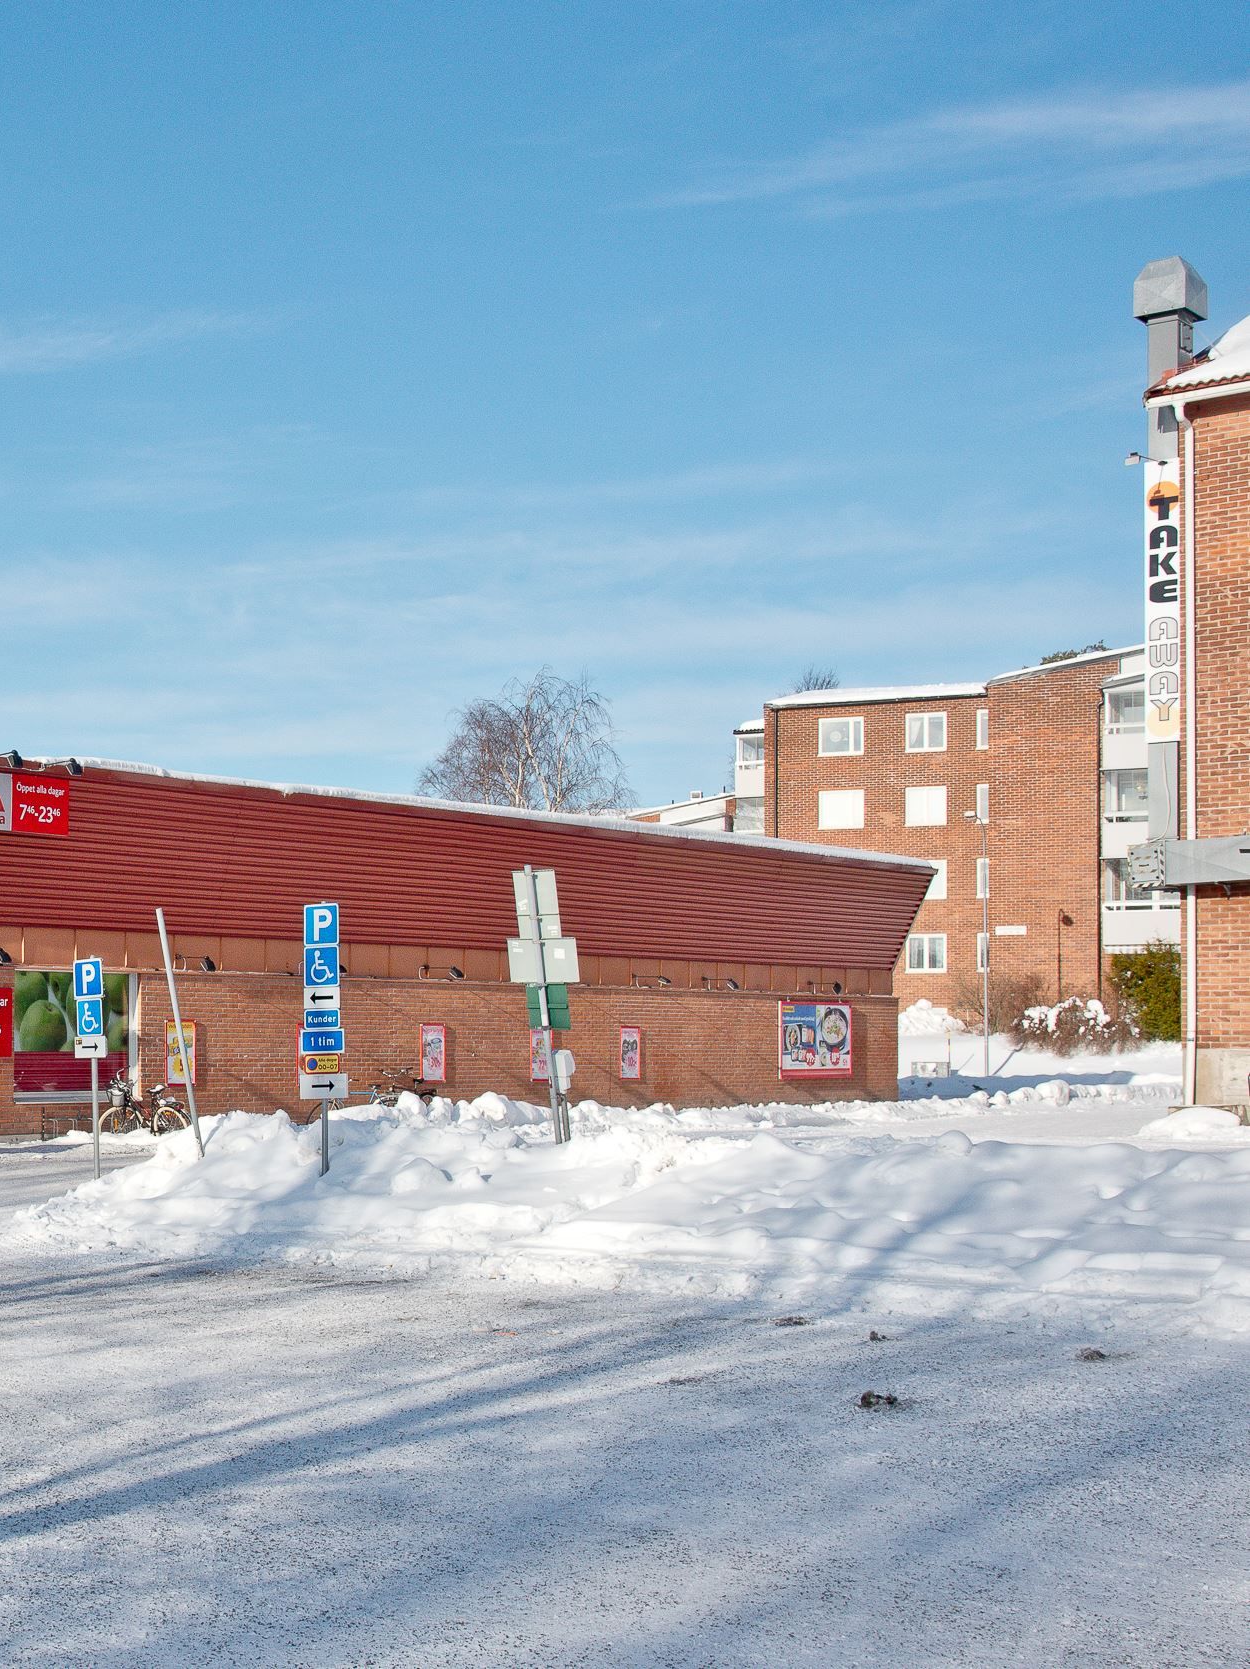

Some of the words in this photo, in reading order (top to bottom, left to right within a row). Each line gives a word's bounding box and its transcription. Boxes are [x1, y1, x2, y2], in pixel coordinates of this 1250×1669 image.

[1149, 494, 1179, 603] TAKE
[1149, 616, 1179, 721] AWAY
[16, 781, 36, 794] Öppet
[37, 784, 47, 794] alla
[48, 785, 66, 798] dagar
[313, 908, 333, 942] P
[81, 963, 96, 994] P
[307, 1014, 337, 1024] Kunder
[310, 1036, 315, 1047] 1
[318, 1036, 335, 1047] tim
